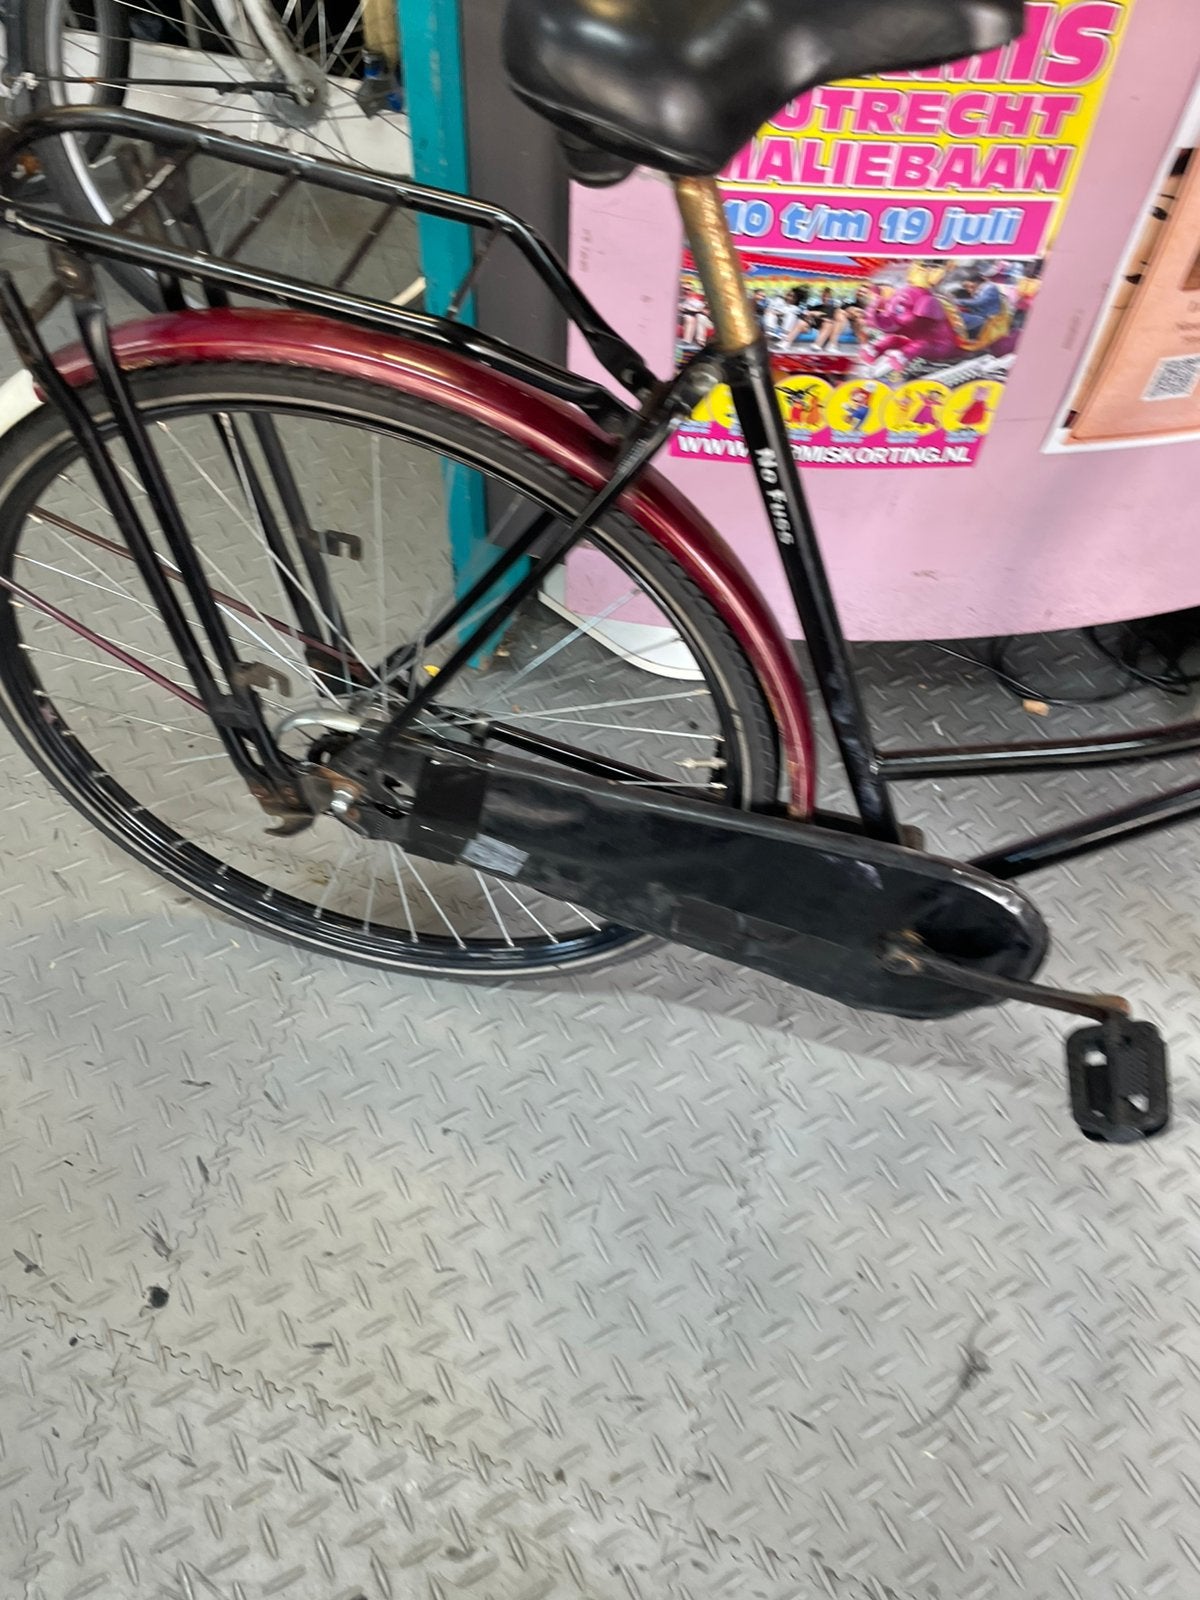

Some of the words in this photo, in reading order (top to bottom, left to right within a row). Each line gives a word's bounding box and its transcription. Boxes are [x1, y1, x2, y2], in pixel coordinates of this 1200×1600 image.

[769, 86, 1080, 137] UTRECHT
[723, 200, 773, 237] 10
[781, 203, 872, 242] t/m
[881, 208, 934, 244] 19
[934, 208, 1025, 250] juli
